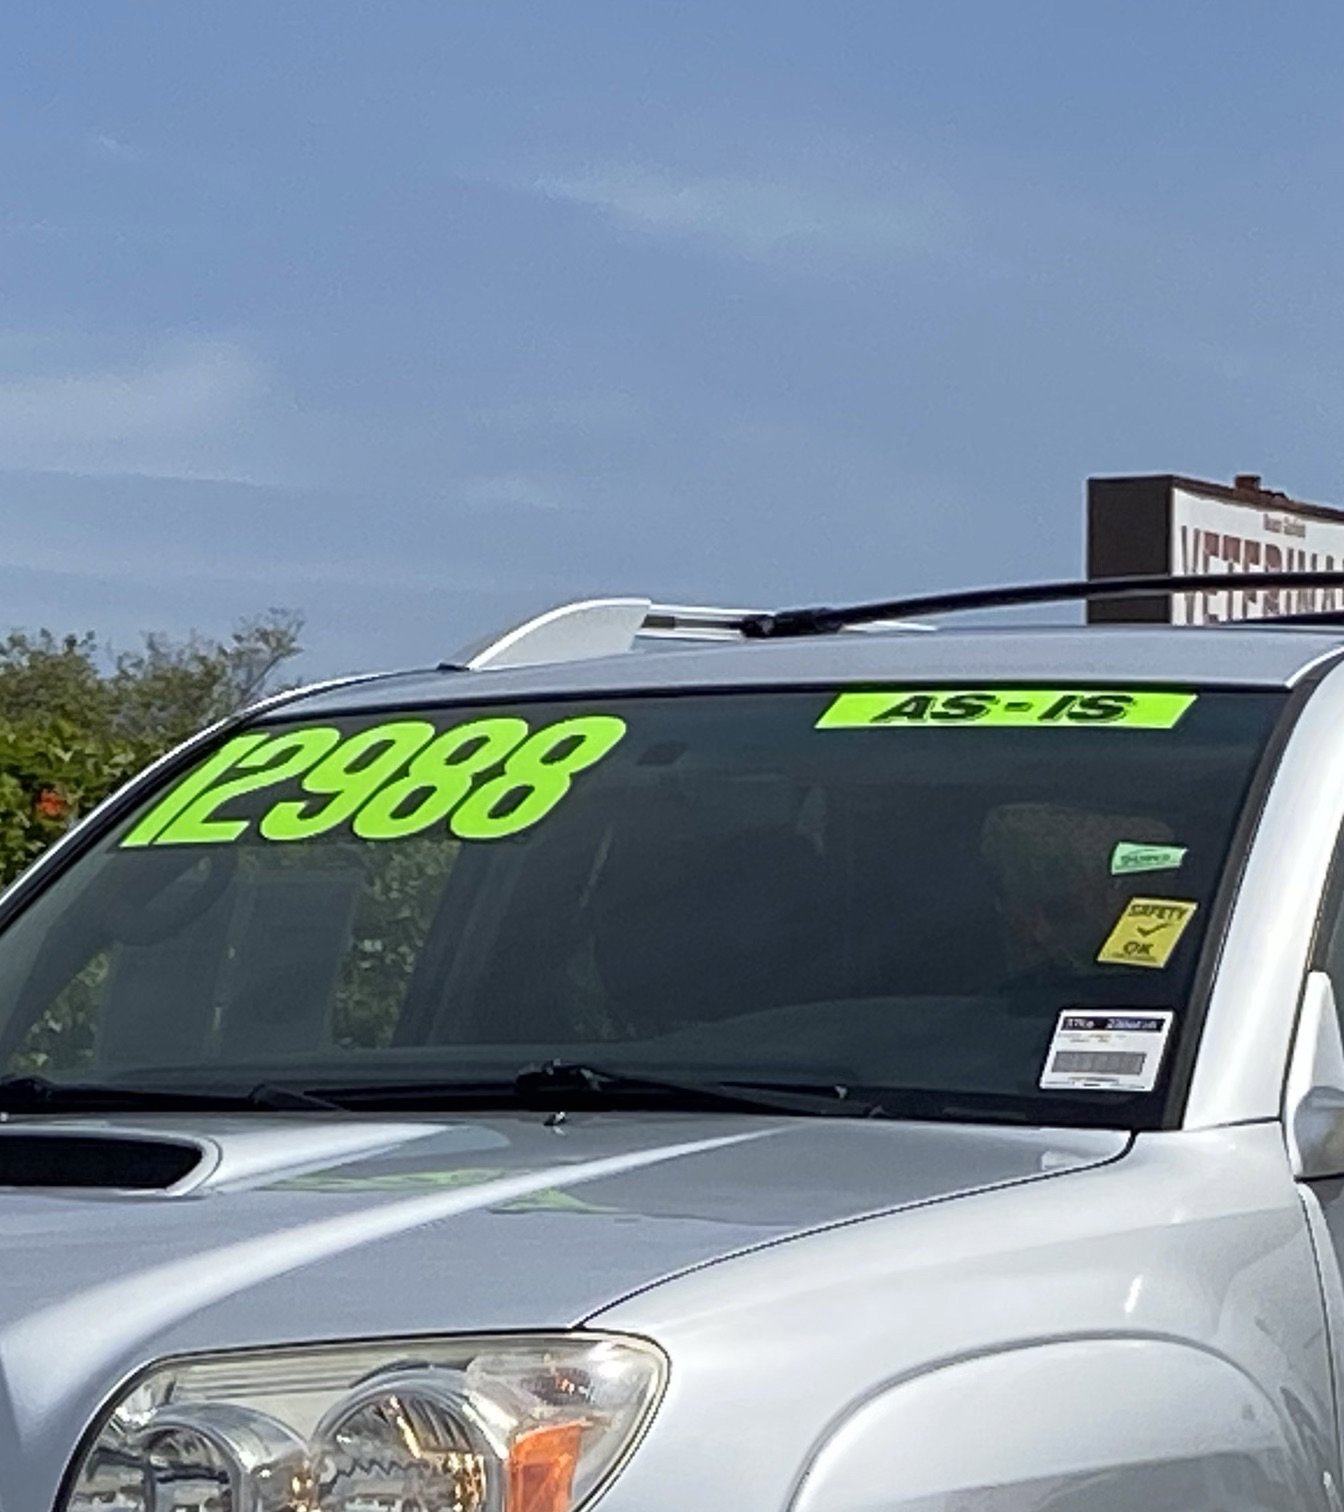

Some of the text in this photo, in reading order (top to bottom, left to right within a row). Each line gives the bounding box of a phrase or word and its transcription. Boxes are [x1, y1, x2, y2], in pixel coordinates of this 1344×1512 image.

[119, 715, 627, 847] 12988
[1128, 904, 1189, 921] SAFETY
[1123, 940, 1154, 956] OK
